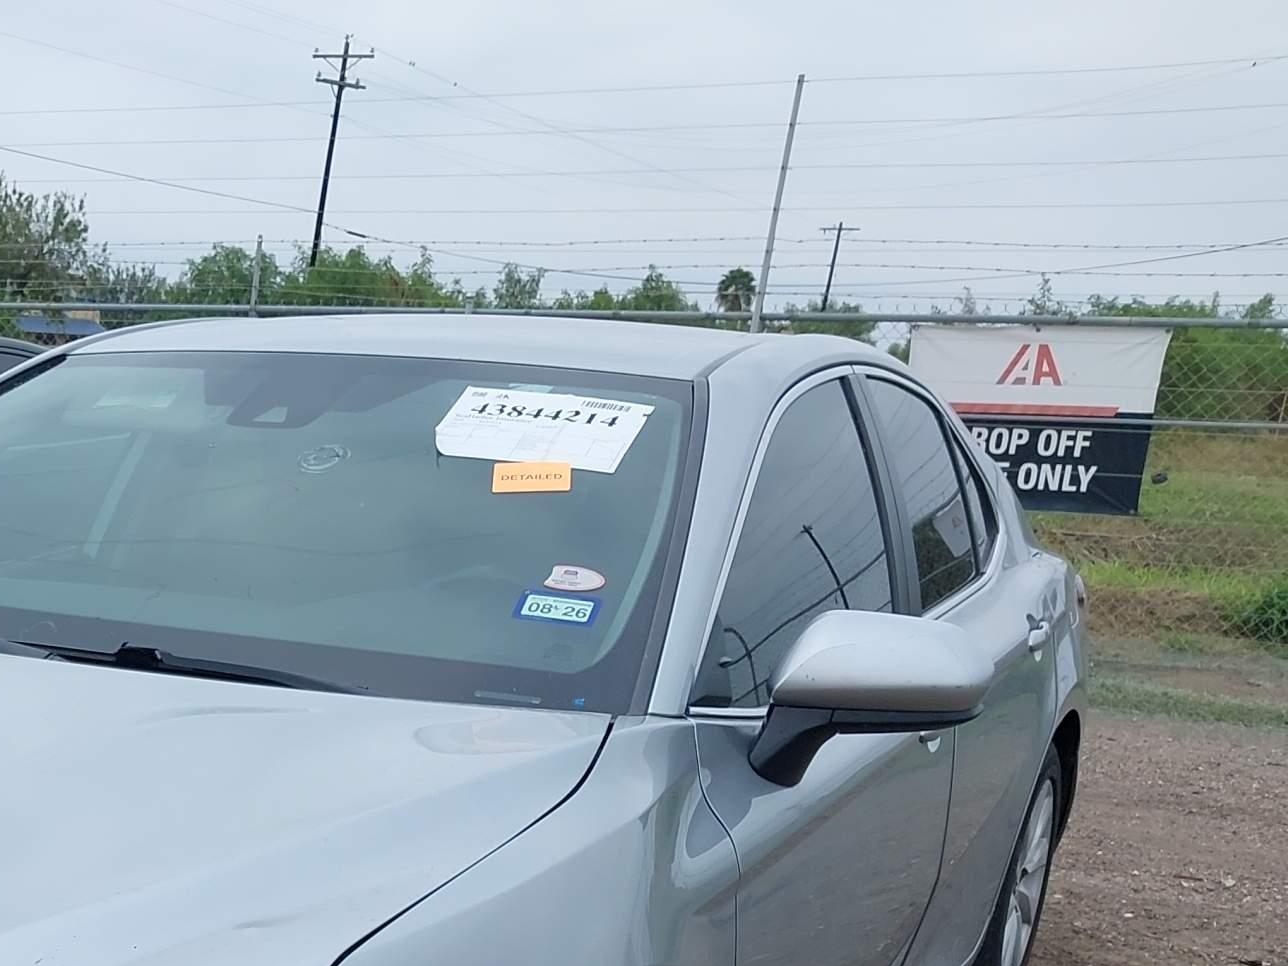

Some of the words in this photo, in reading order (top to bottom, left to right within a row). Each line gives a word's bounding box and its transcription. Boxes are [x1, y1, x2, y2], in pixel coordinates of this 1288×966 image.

[471, 403, 620, 427] 43844214
[970, 427, 1030, 456] ROP
[1037, 428, 1093, 458] OFF
[500, 472, 563, 482] DETAILED
[1017, 462, 1098, 493] ONLY
[528, 602, 553, 614] 08
[561, 606, 588, 619] 26
